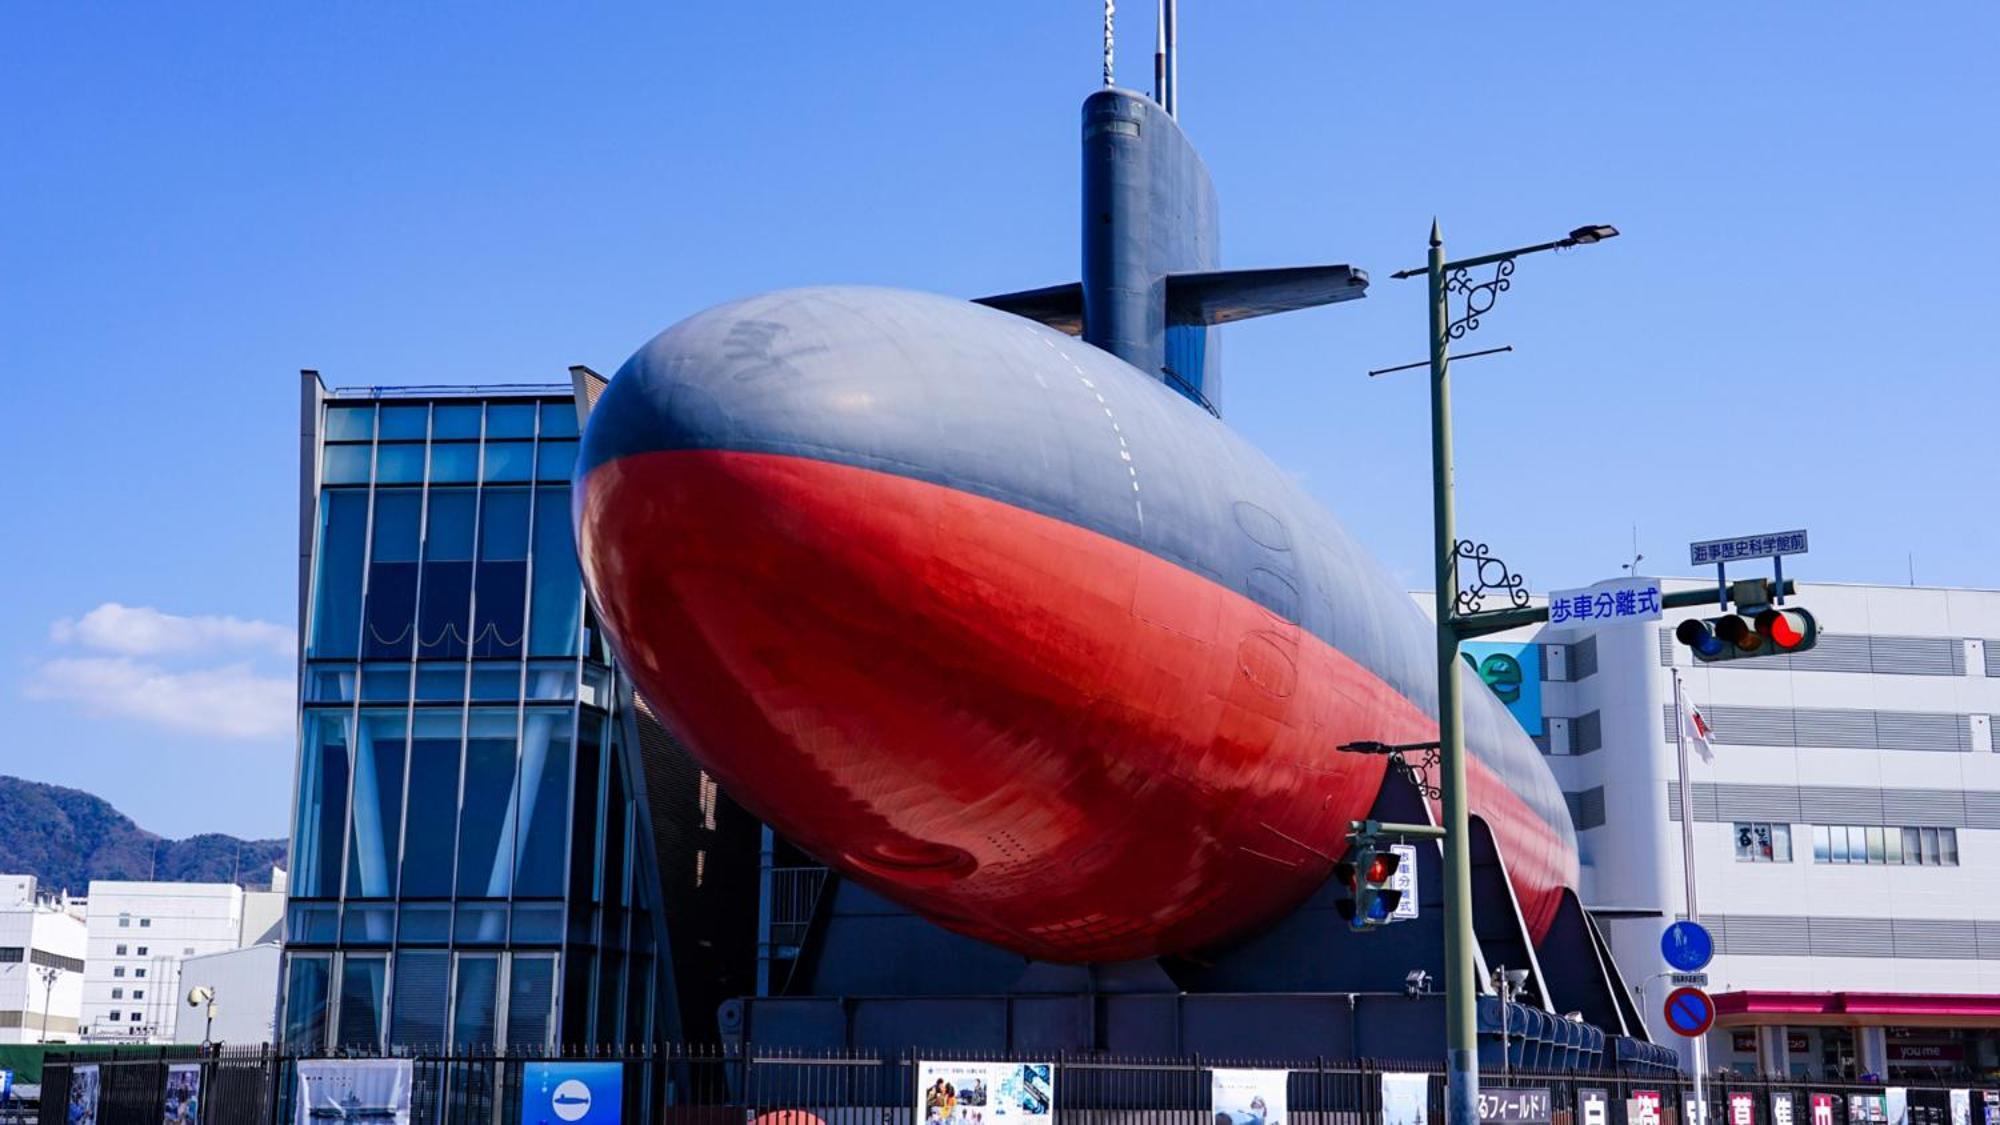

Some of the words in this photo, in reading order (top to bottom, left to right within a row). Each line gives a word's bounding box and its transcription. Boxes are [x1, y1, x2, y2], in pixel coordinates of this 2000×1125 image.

[1694, 534, 1804, 562] 海事歴史科学館前
[1551, 587, 1659, 623] 歩車分離式
